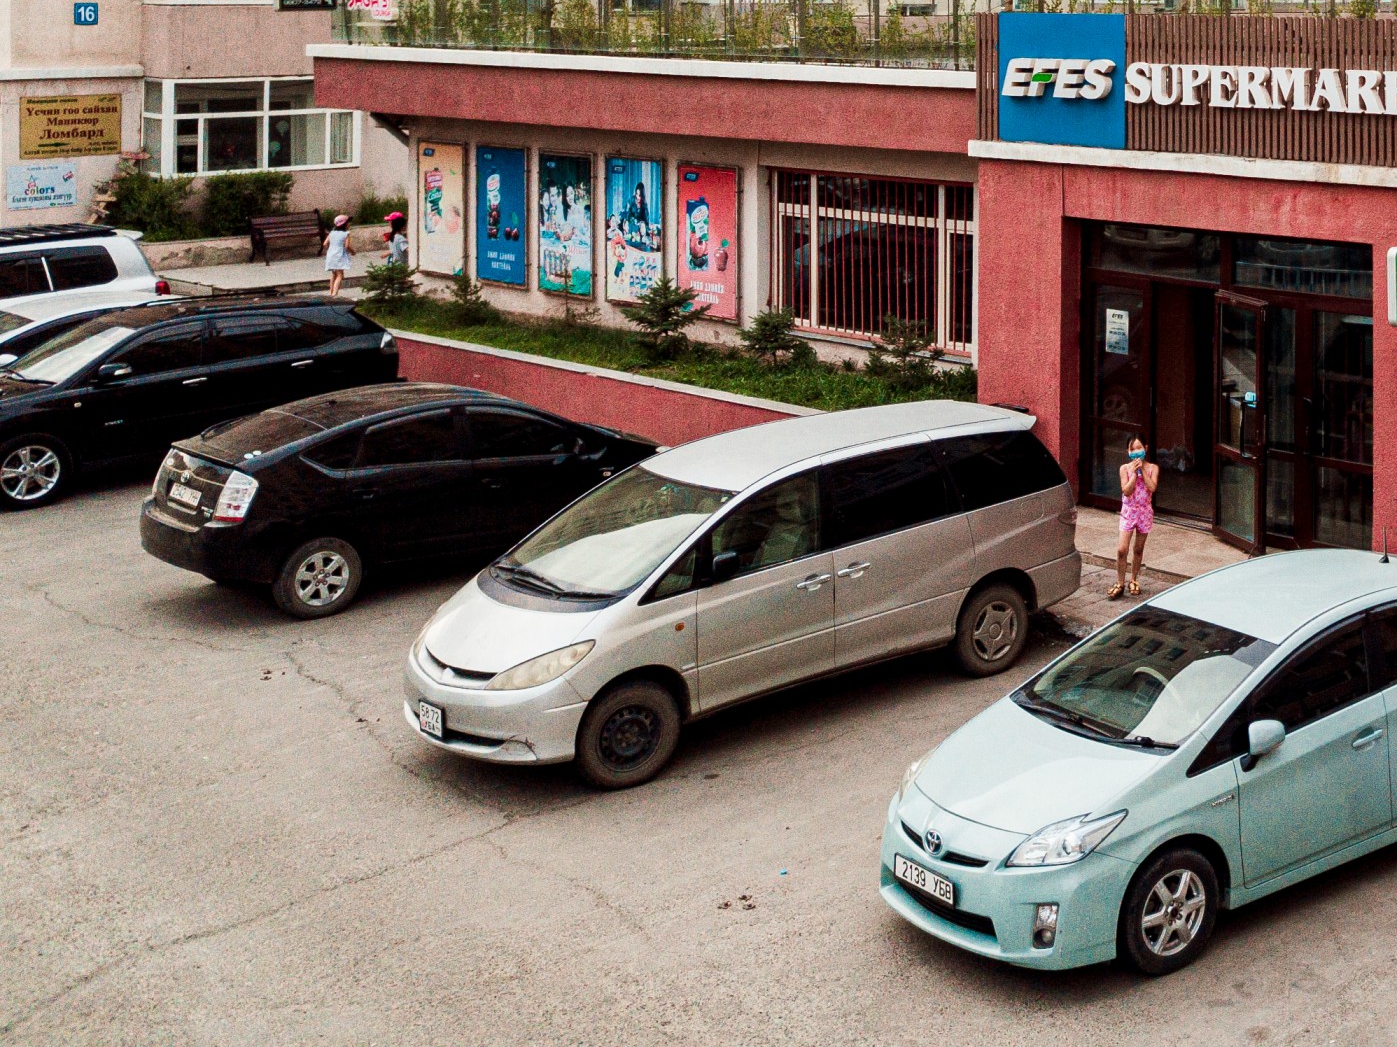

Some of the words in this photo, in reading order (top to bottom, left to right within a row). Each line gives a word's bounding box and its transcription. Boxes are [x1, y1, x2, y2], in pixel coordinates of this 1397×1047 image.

[78, 6, 95, 21] 16
[1002, 57, 1117, 100] EFES
[82, 105, 118, 114] сайхан
[46, 117, 99, 127] Маникюр
[40, 128, 104, 140] Ломбард
[902, 861, 926, 887] 2139
